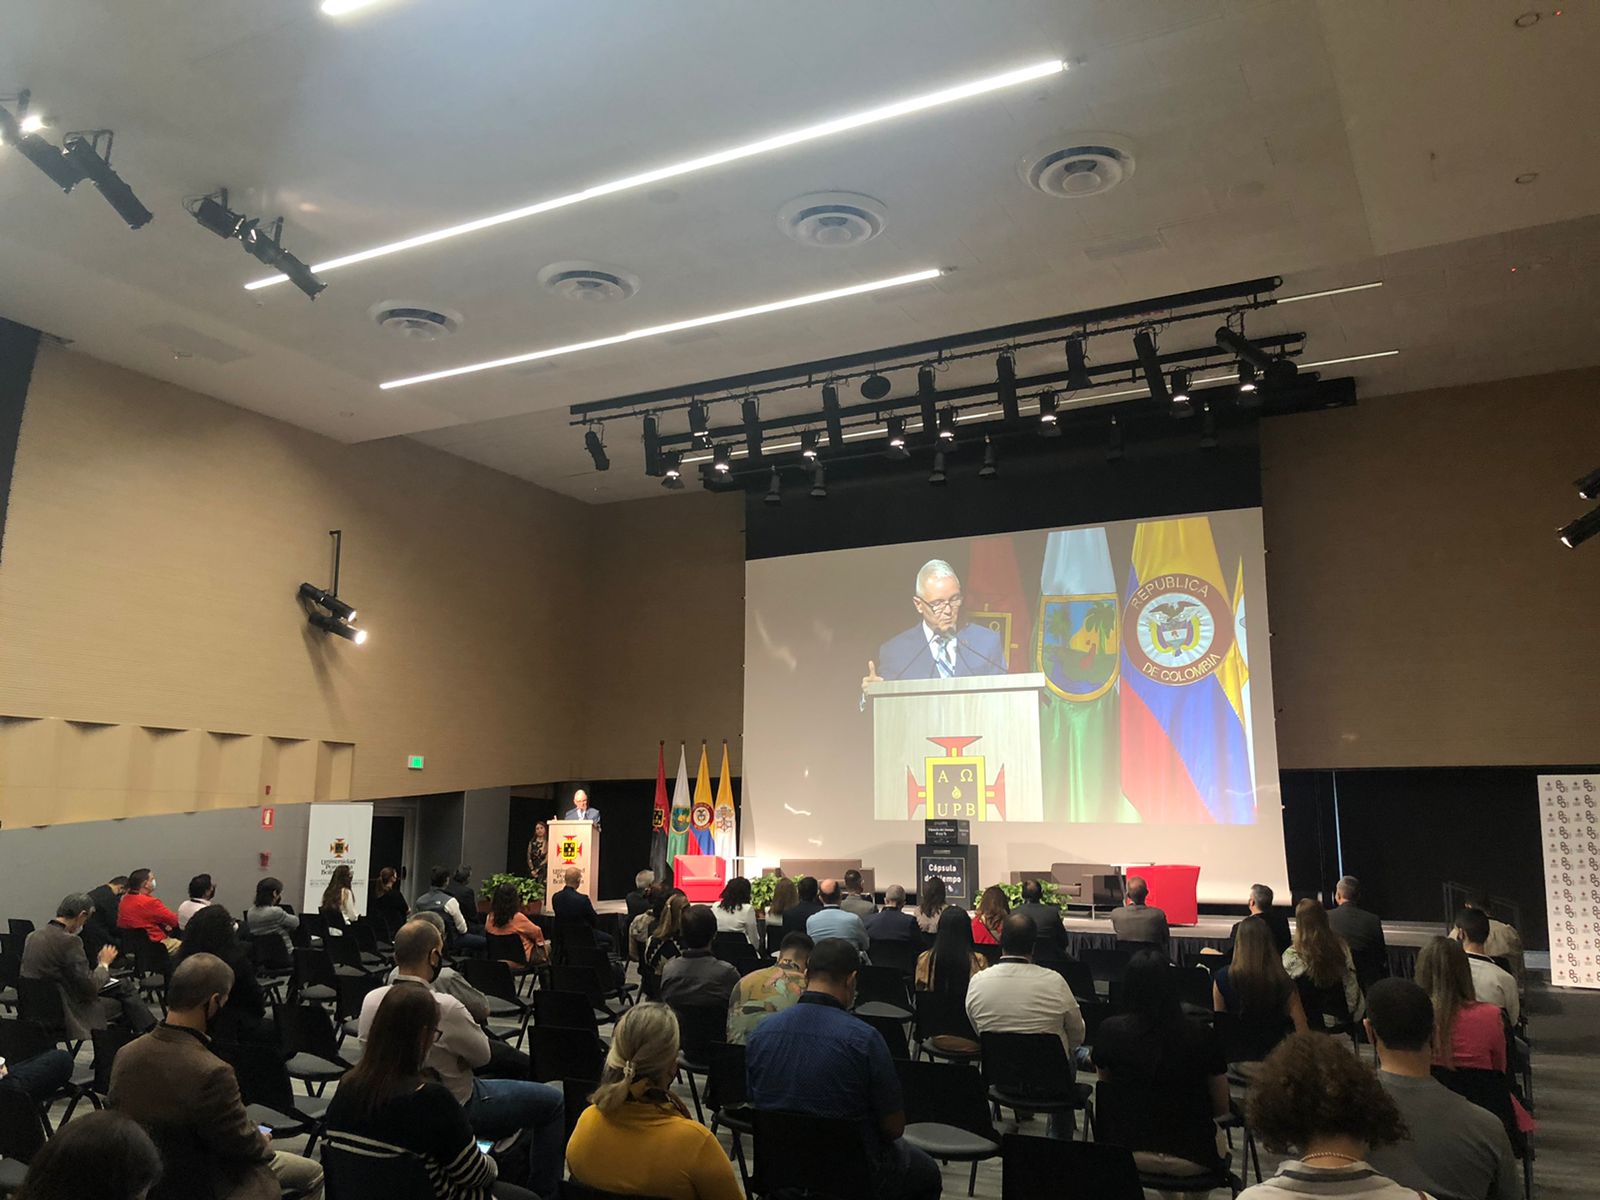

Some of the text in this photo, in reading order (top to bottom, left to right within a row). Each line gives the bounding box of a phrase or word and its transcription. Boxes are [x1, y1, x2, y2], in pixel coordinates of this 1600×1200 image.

[1131, 576, 1209, 609] REPUBLICA
[1142, 653, 1221, 682] DE COLOMBIA
